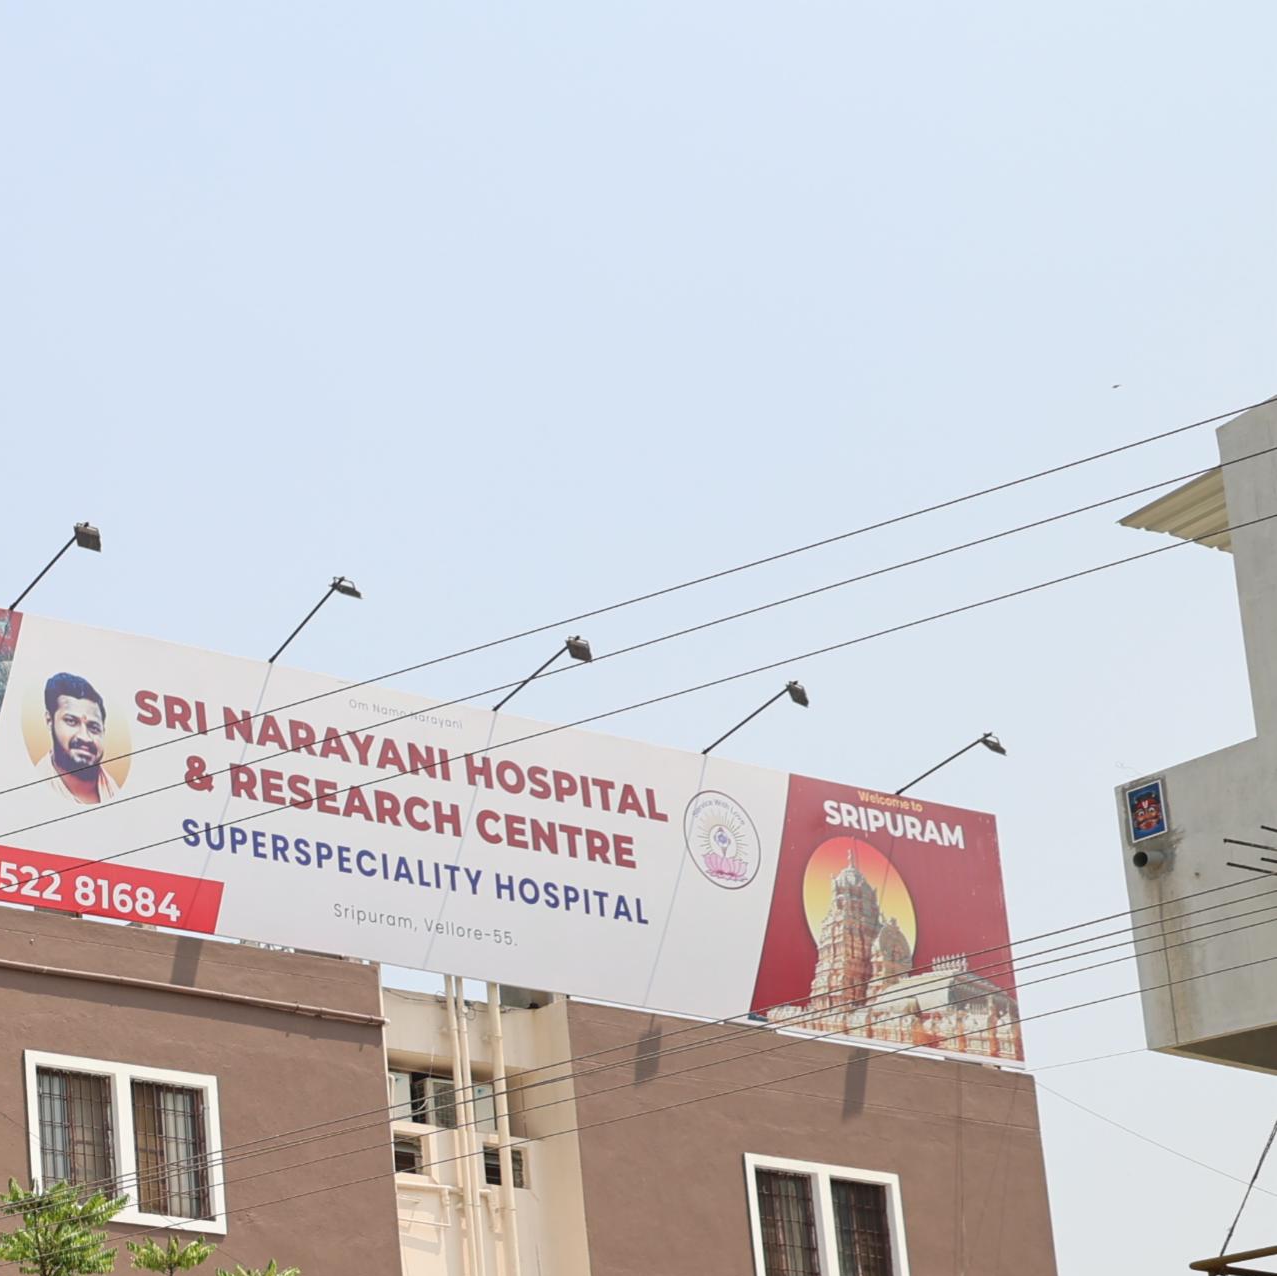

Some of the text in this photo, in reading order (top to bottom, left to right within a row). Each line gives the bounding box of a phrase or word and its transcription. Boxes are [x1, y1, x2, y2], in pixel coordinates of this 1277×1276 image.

[349, 699, 368, 711] Om
[410, 711, 463, 729] Narayani
[133, 689, 669, 825] SRI NARAYANI HOSPITAL
[184, 754, 637, 870] & RESEARCH CENTRE
[858, 791, 923, 812] Welcome to
[823, 800, 965, 849] SRIPURAM
[181, 817, 649, 926] SUPERSPECIALITY HOSPITAL
[73, 881, 182, 923] 81684
[334, 904, 518, 946] Sripuram, Vellore-55.
